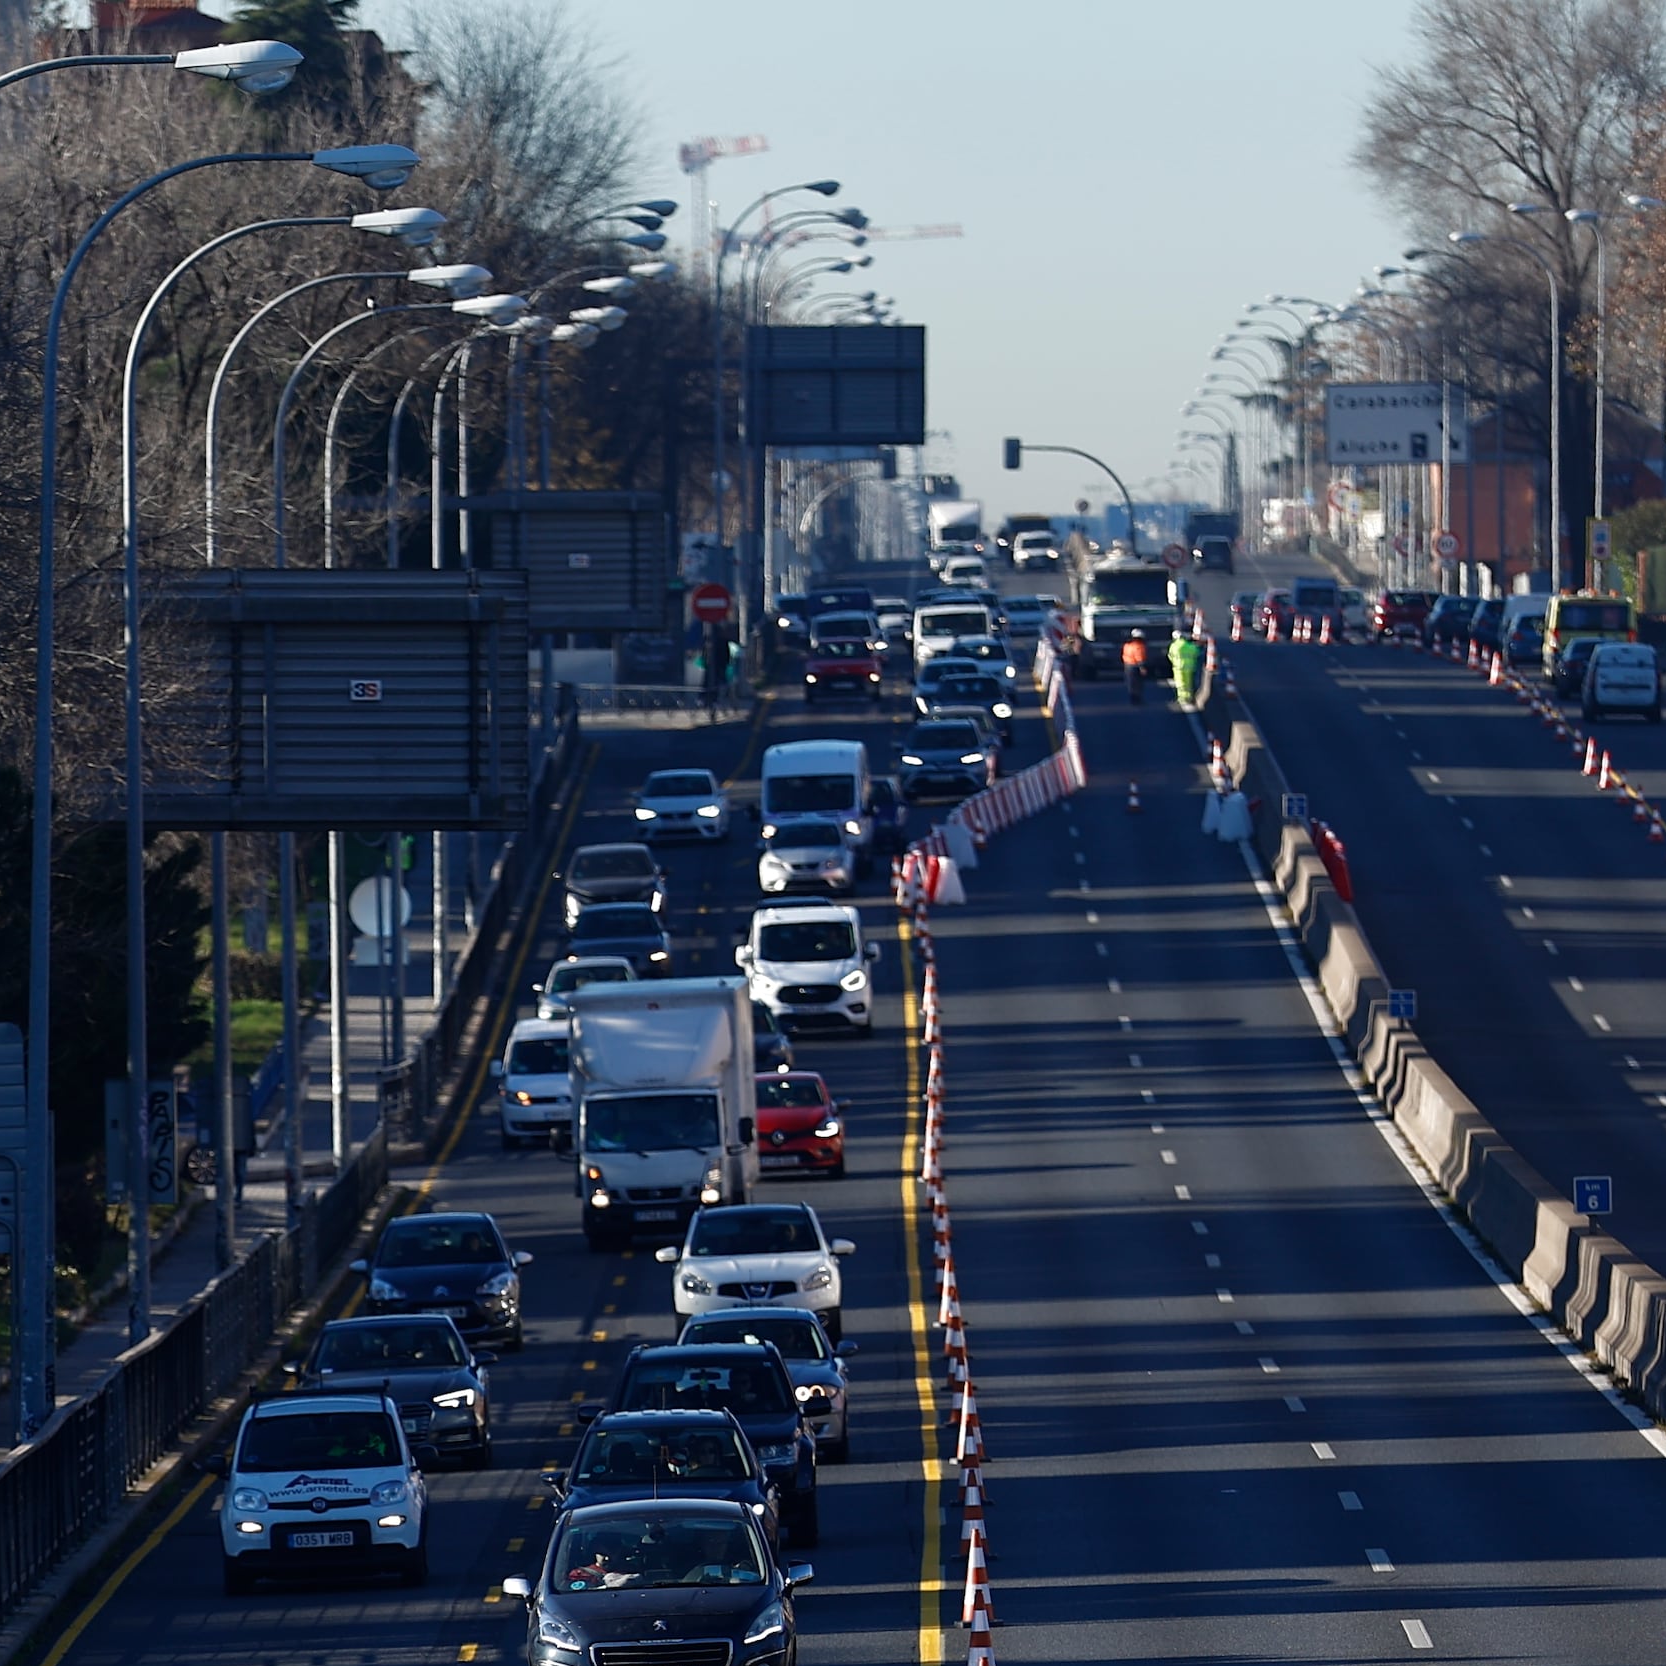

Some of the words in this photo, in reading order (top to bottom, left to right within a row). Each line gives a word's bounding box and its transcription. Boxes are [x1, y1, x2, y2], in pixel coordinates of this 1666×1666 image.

[354, 683, 378, 697] 3S
[1588, 1195, 1599, 1210] 6
[269, 1485, 369, 1498] www.ametel.es
[296, 1533, 325, 1546] 0351
